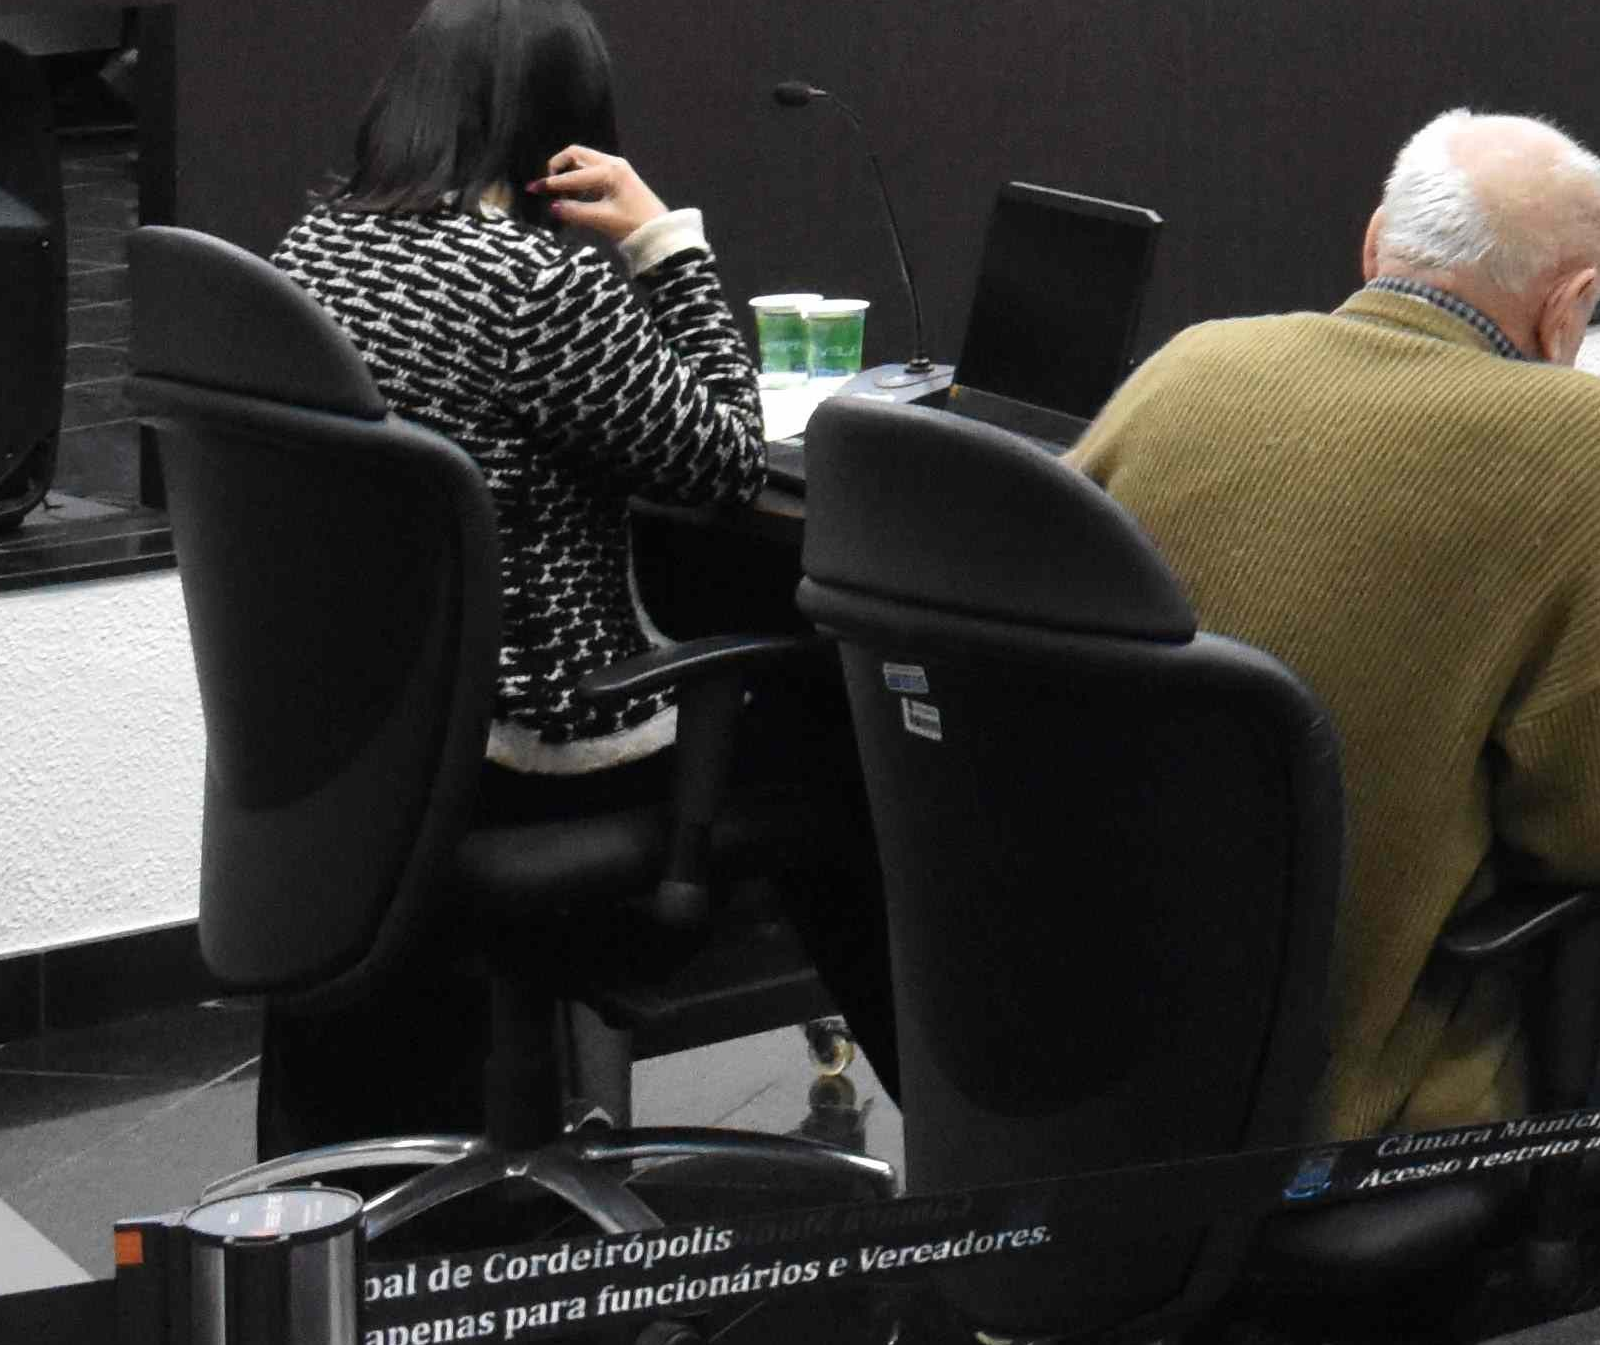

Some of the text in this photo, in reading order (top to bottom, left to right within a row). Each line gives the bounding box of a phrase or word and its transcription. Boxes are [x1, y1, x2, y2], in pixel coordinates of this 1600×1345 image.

[1355, 1159, 1462, 1190] Acesso
[1466, 1138, 1581, 1170] restrito
[1377, 1127, 1494, 1158] Câmara
[427, 1258, 473, 1294] de
[483, 1224, 734, 1285] Cordeirópolis
[503, 1295, 587, 1341] para
[596, 1258, 822, 1316] funcionários
[828, 1254, 848, 1278] e
[858, 1223, 1053, 1273] Vereadores.
